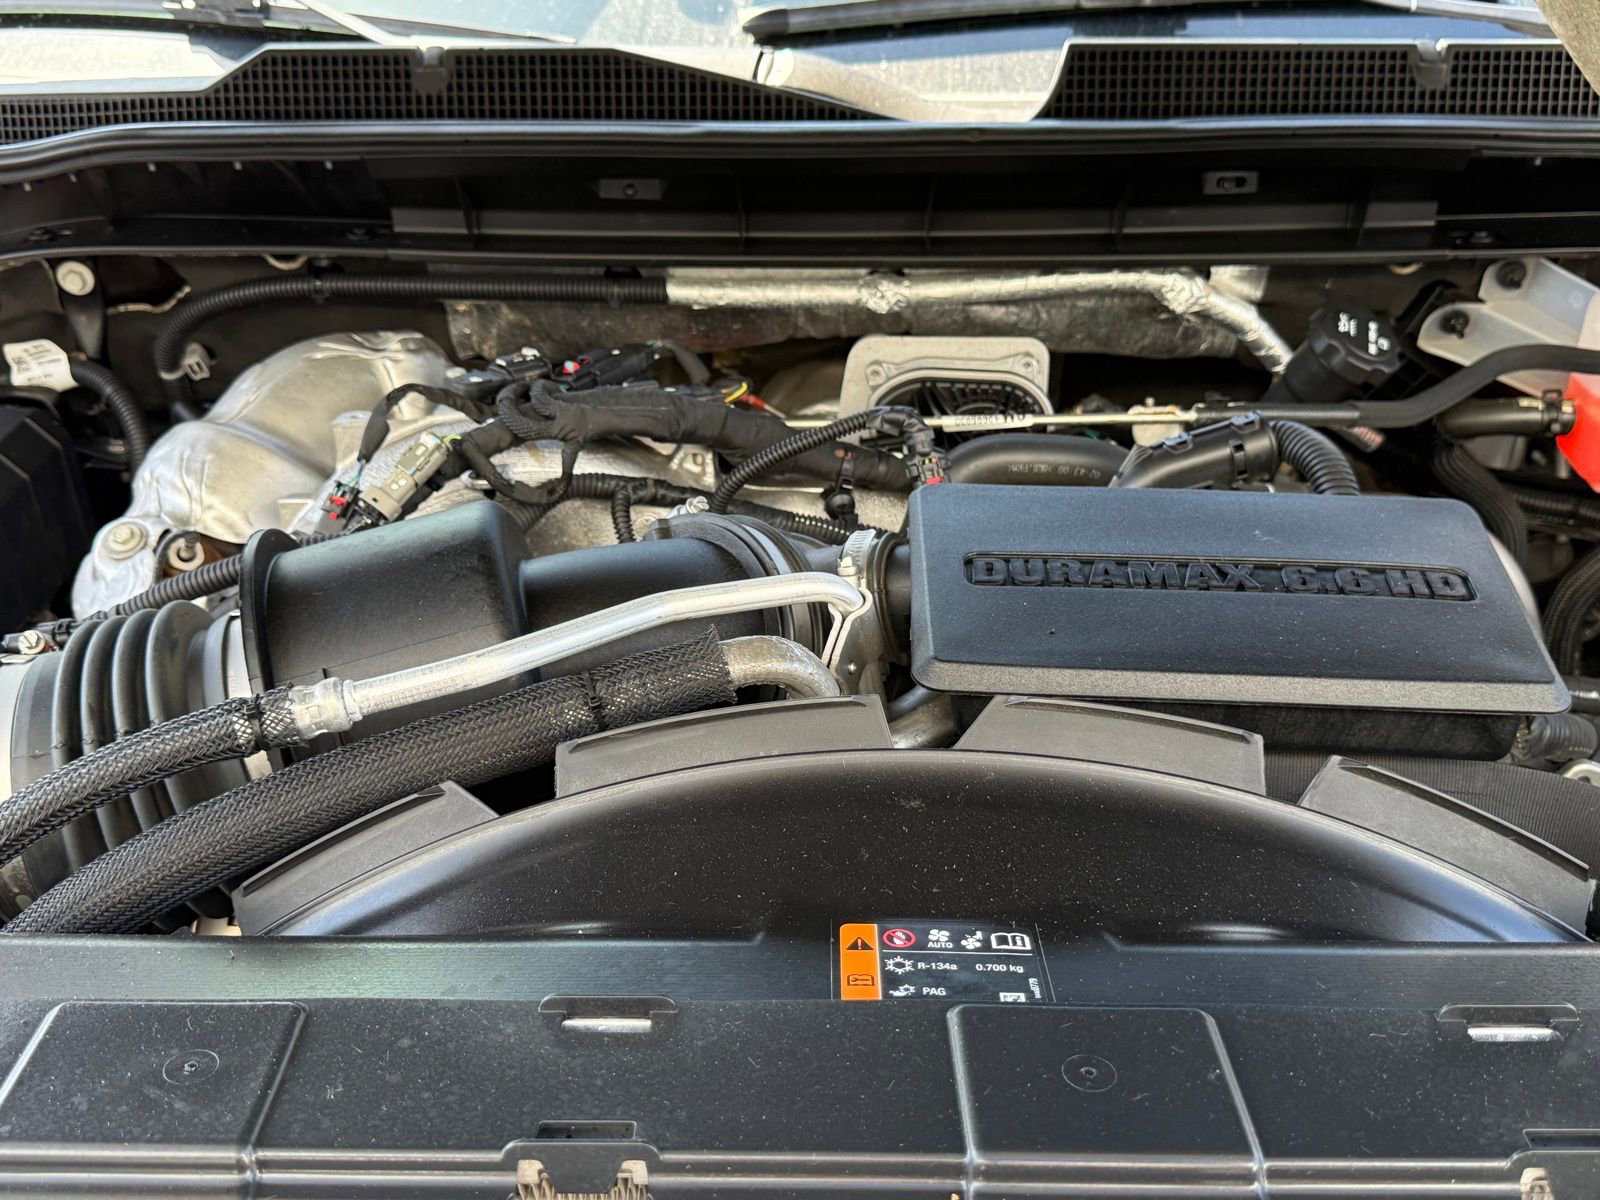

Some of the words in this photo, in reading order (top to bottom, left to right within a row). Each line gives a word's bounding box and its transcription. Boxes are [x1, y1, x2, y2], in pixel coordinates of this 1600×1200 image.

[972, 558, 1262, 591] DURAMAX
[1281, 566, 1377, 595] 6.6
[1385, 569, 1468, 599] HD
[927, 941, 953, 949] AUTO
[917, 961, 958, 971] R-134a
[975, 963, 1007, 972] 0.700
[1009, 964, 1024, 974] kg
[922, 986, 947, 996] PAG
